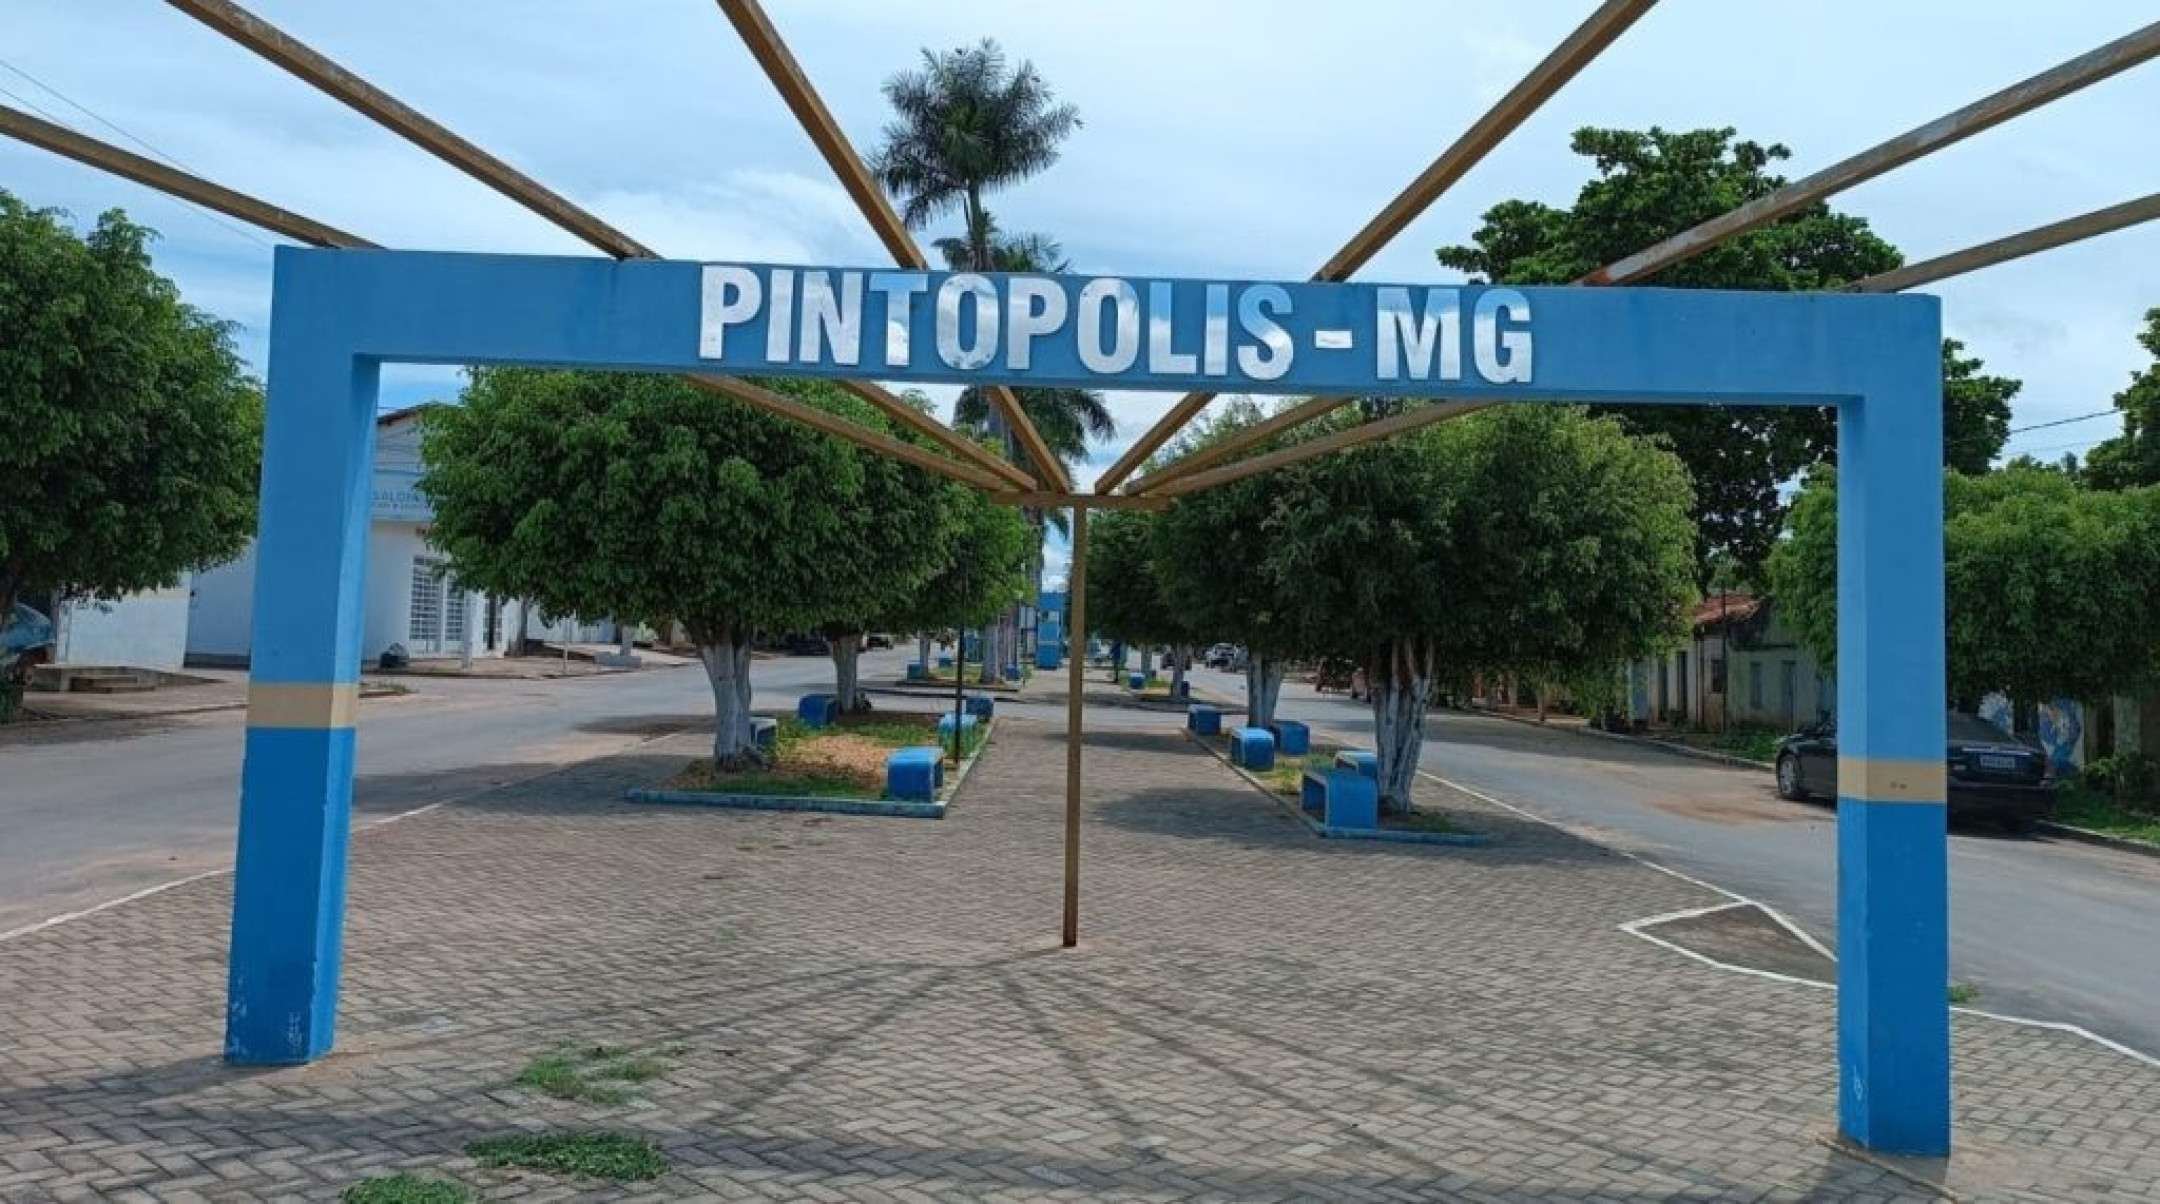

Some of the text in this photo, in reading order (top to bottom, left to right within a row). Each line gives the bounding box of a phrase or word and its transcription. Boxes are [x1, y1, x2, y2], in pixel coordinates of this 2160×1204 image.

[700, 265, 1532, 382] PINTOPOLIS - MG
